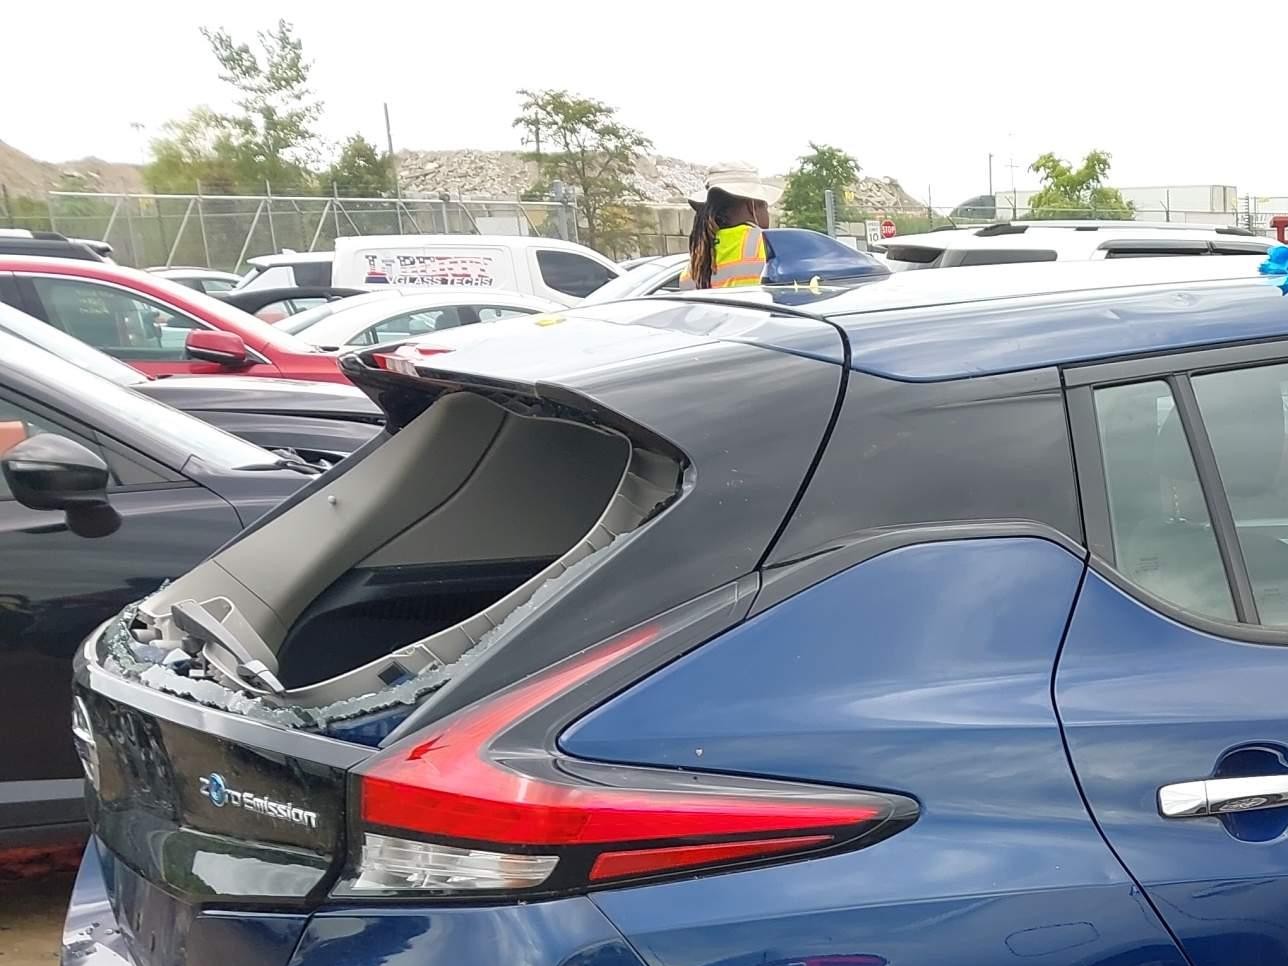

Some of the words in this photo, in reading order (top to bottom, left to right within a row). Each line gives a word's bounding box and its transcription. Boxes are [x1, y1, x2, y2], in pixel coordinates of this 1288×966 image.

[882, 225, 895, 234] STOP
[869, 232, 879, 241] 10
[397, 276, 443, 285] GLASS
[242, 792, 318, 829] Emission
